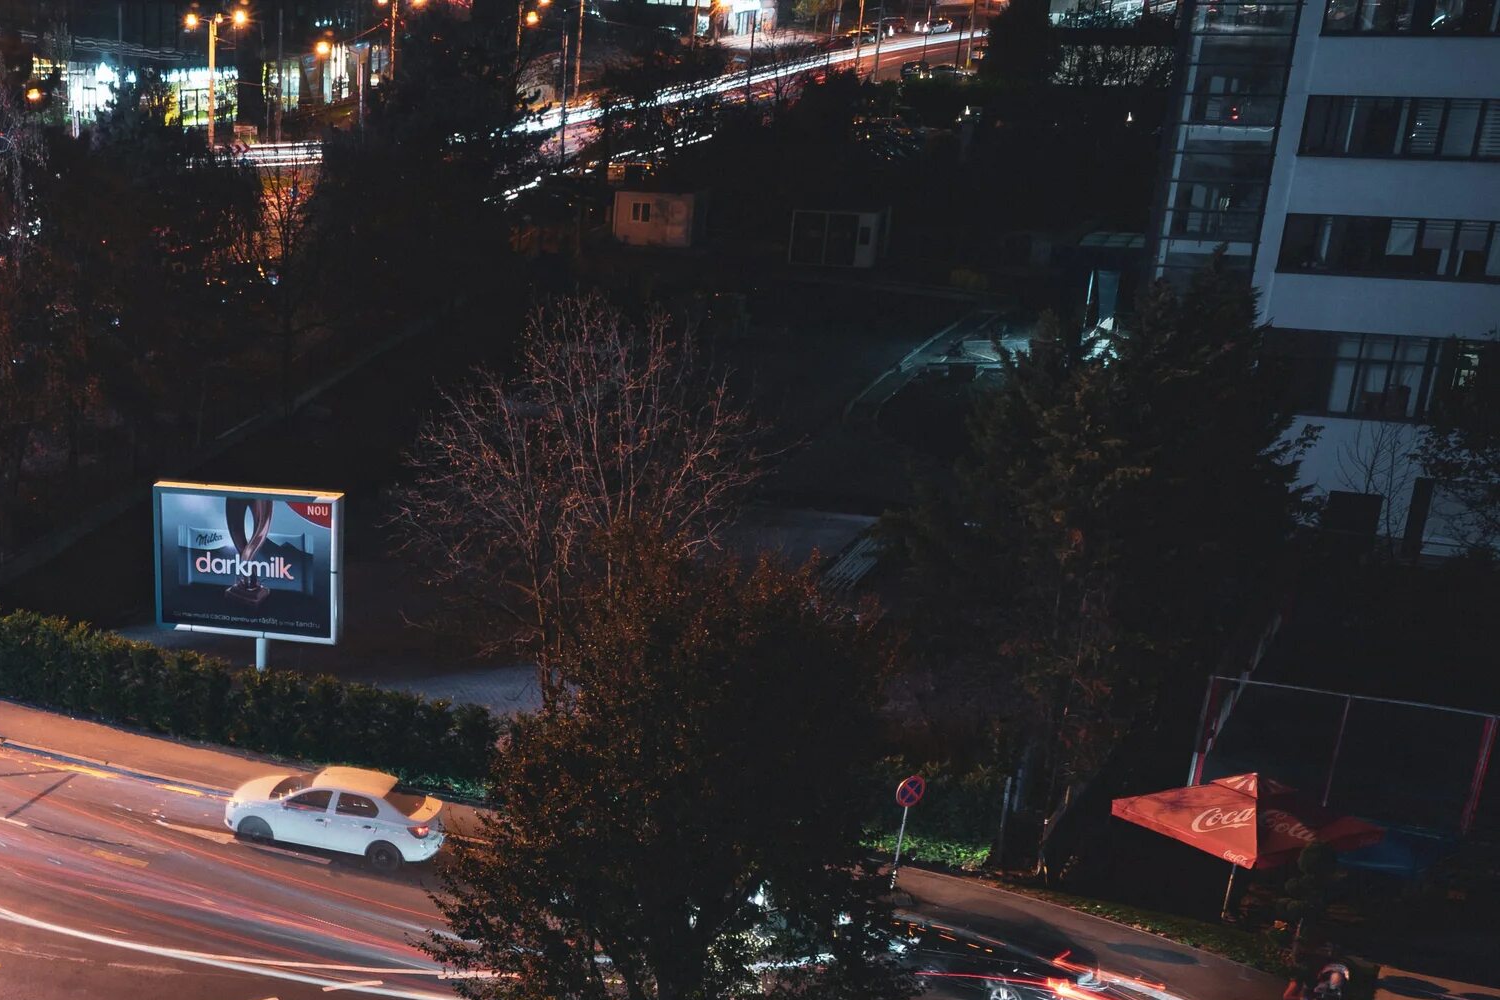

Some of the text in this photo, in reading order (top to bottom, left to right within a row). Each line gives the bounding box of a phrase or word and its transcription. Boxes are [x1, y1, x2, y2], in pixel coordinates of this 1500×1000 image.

[307, 505, 329, 516] NOU
[195, 529, 223, 546] Milka
[195, 551, 295, 581] darkmilk
[210, 613, 230, 621] cacao
[295, 620, 321, 629] tandru
[1191, 807, 1255, 833] Coca
